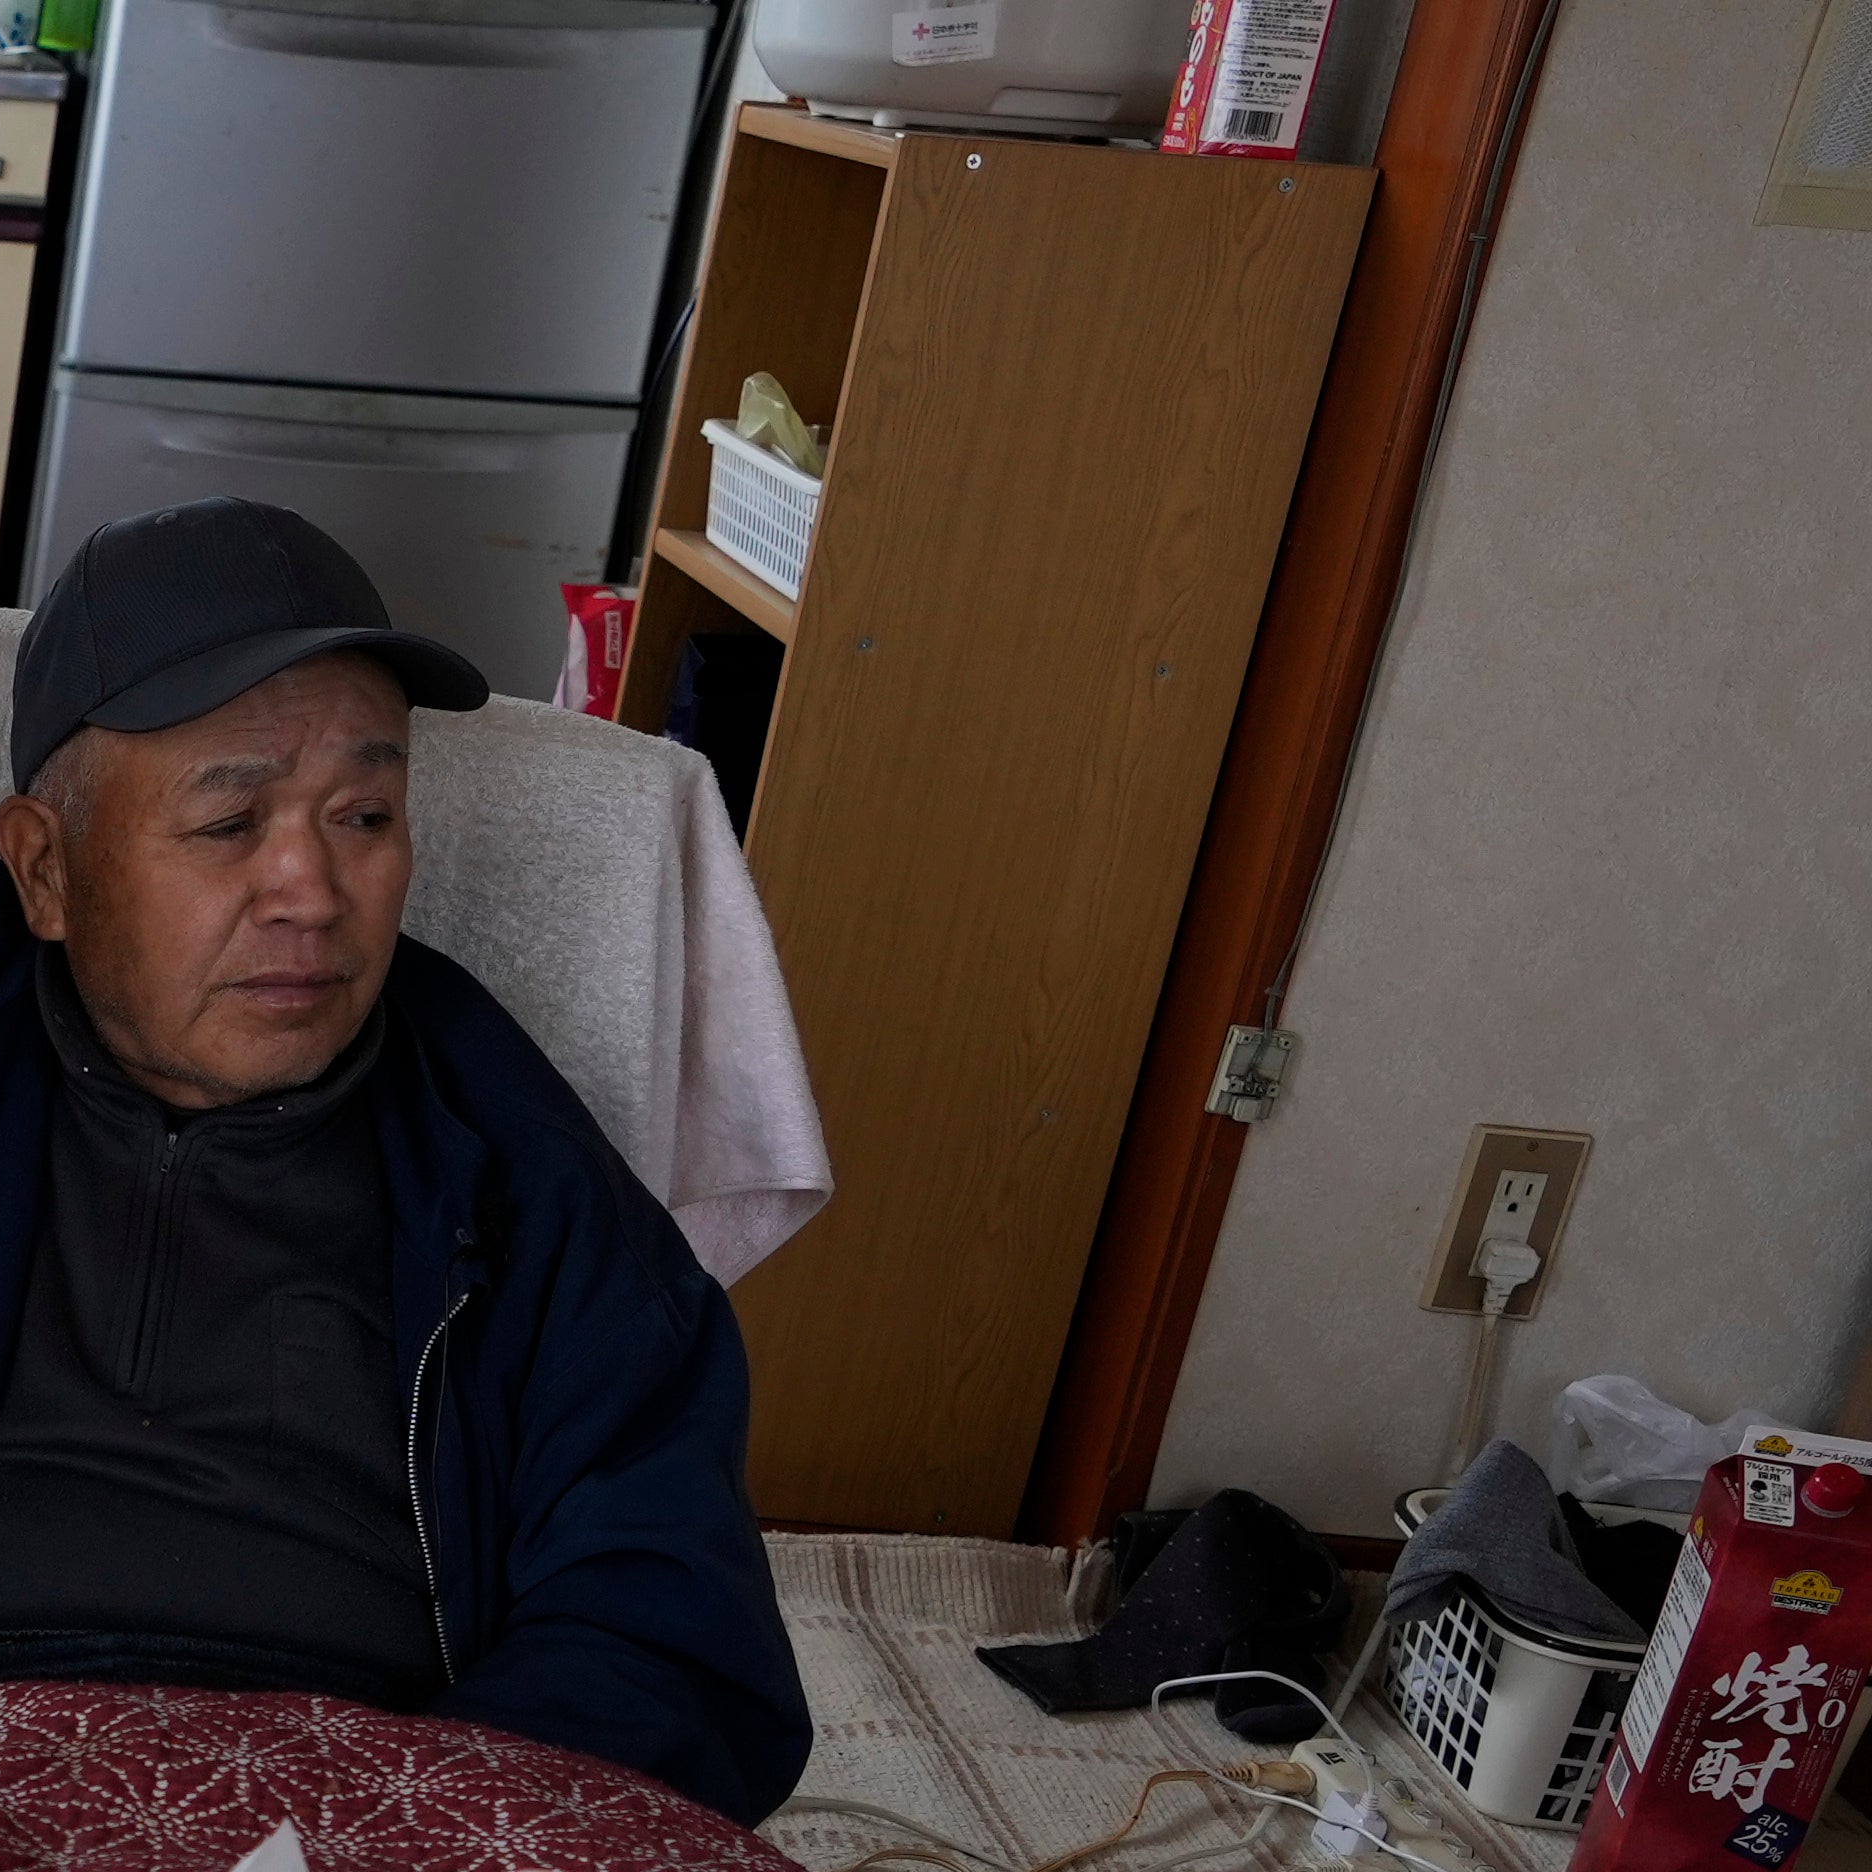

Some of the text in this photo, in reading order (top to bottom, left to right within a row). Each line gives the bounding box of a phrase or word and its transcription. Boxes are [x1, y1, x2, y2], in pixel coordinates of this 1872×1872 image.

[1265, 71, 1275, 79] OF
[1277, 72, 1302, 81] JAPAN
[1777, 1583, 1835, 1600] TOPVALU
[1688, 1644, 1829, 1814] 焼酎
[1756, 1813, 1790, 1837] alc.
[1732, 1825, 1785, 1864] 25%
